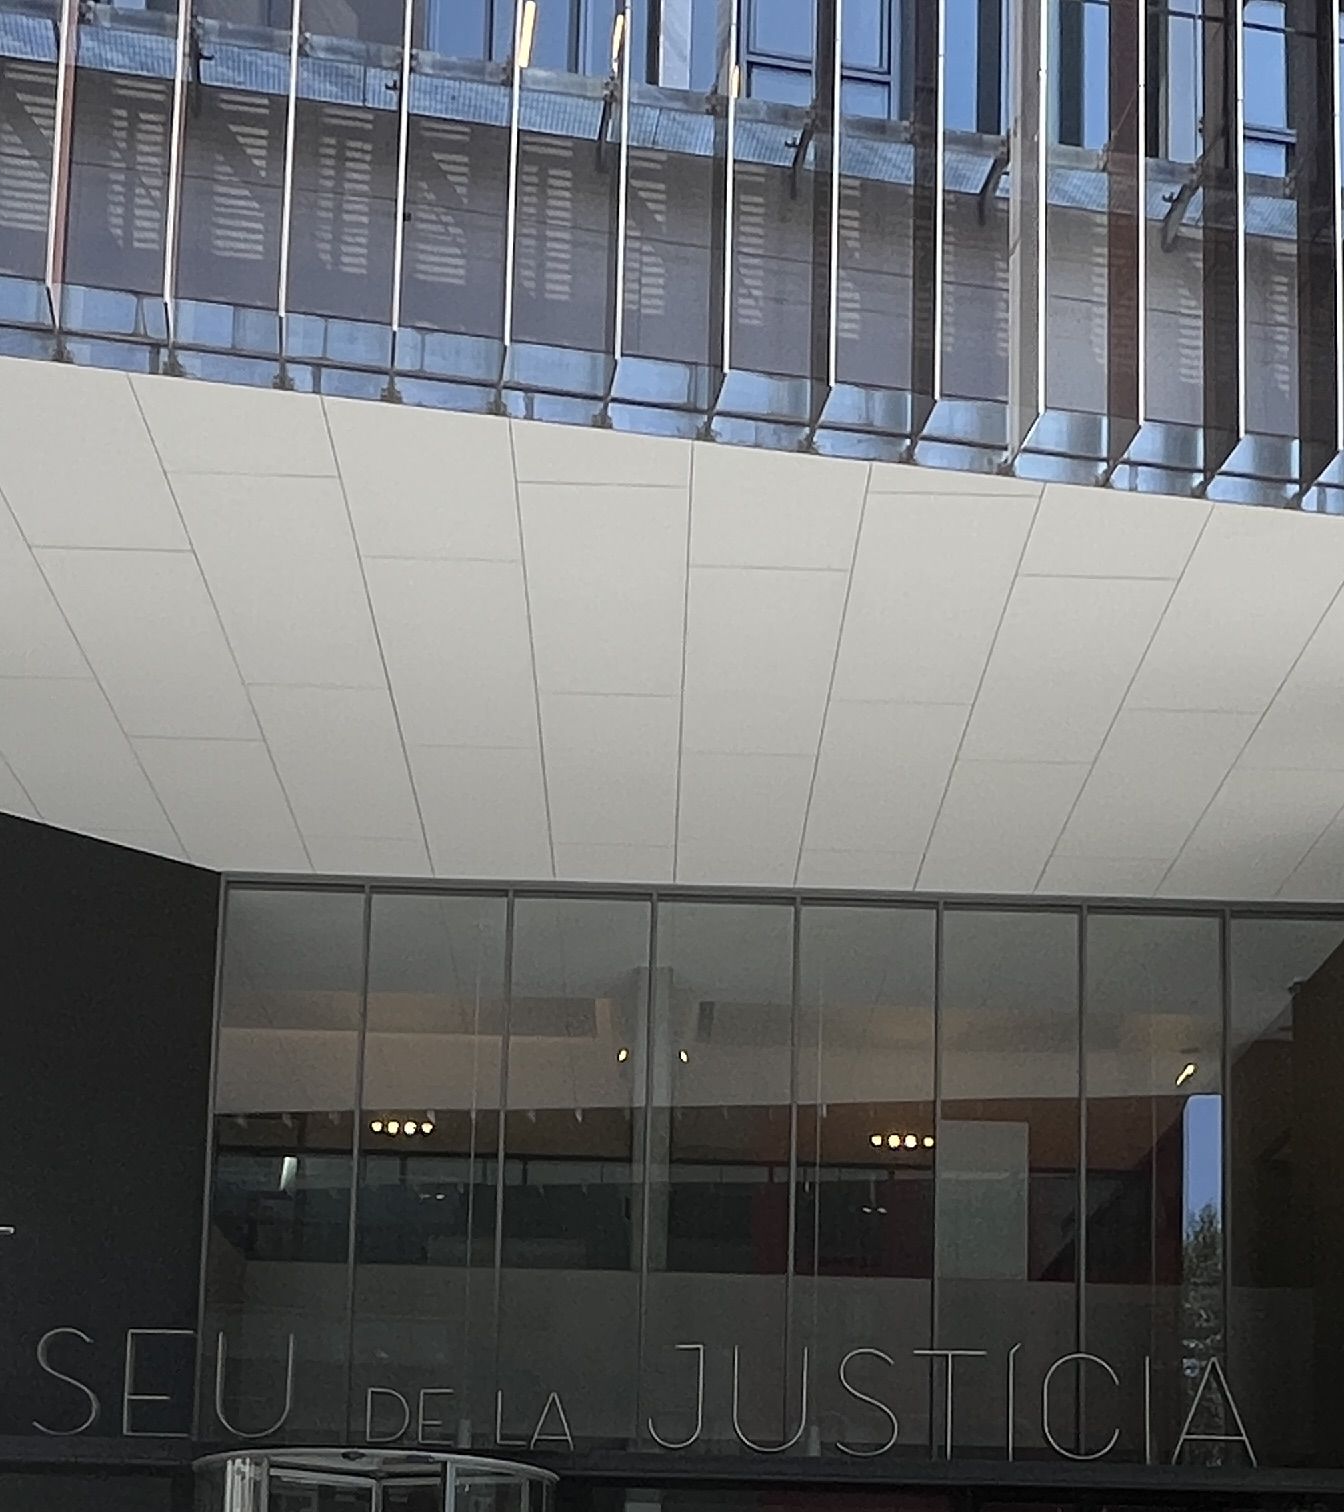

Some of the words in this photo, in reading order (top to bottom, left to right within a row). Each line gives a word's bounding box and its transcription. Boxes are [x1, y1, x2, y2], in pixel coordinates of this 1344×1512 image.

[32, 1326, 295, 1439] SEU
[365, 1386, 455, 1448] DE
[495, 1388, 575, 1451] LA
[647, 1341, 1258, 1466] JUSTÍCIA
